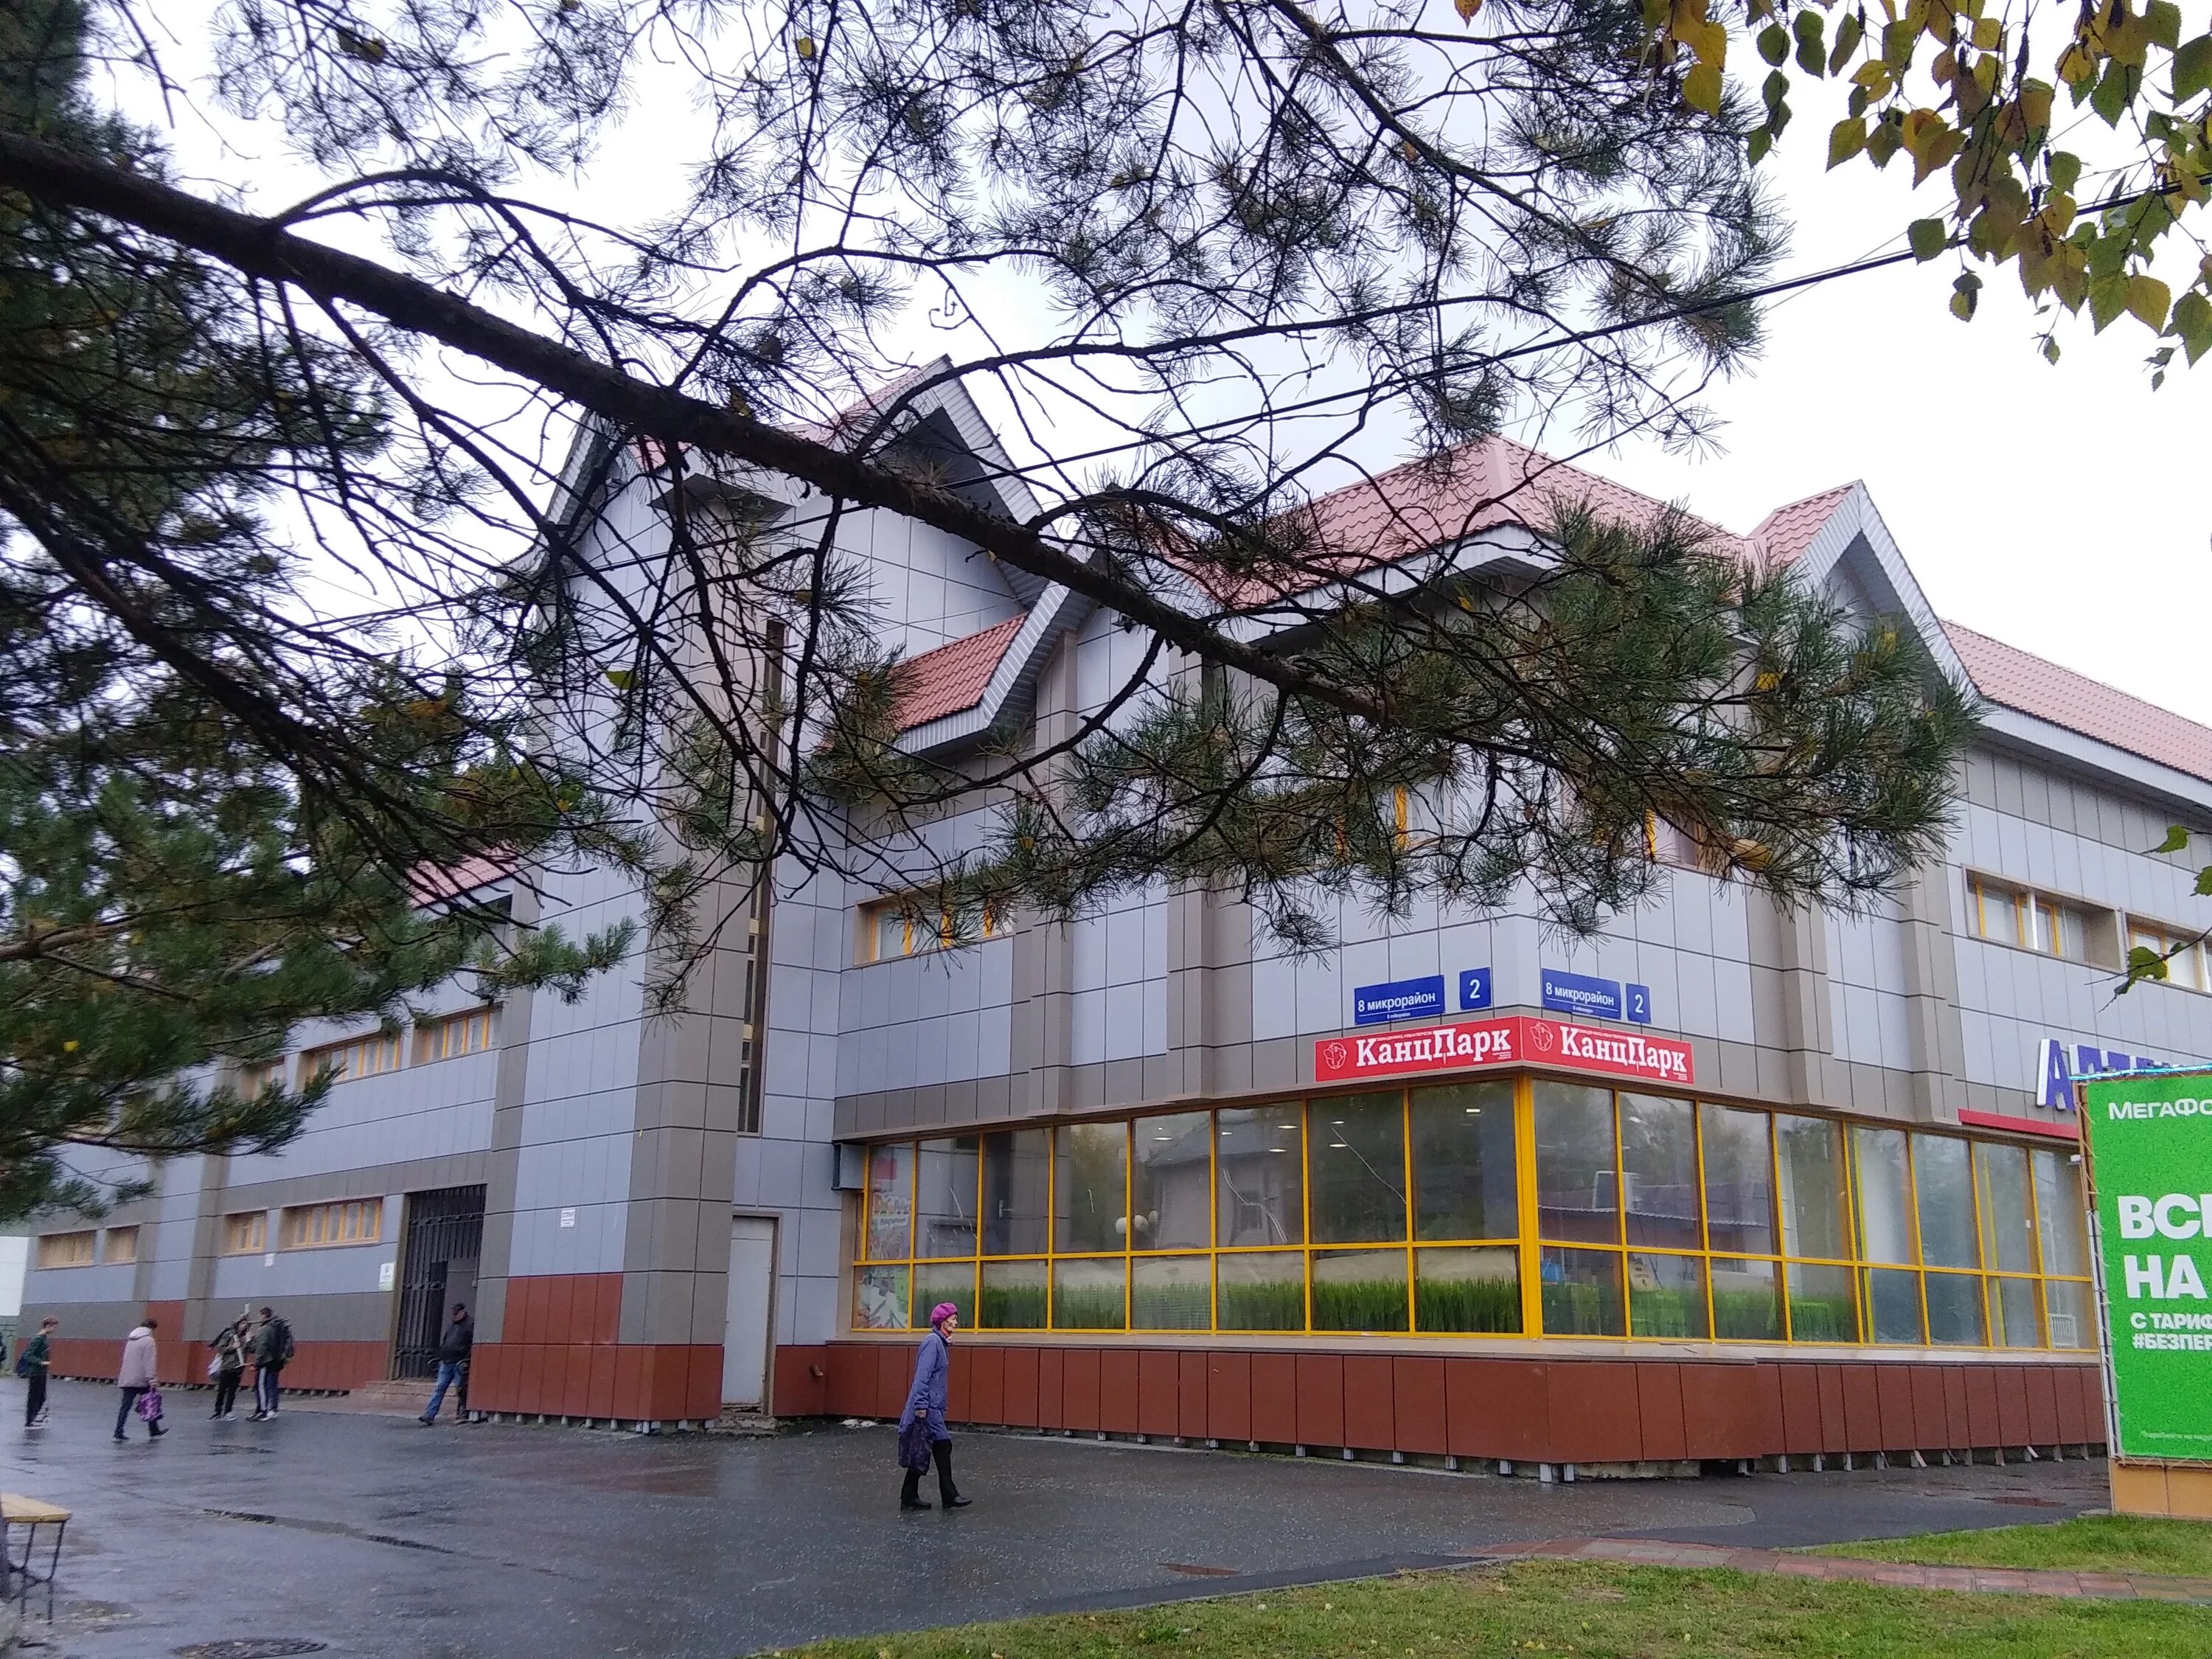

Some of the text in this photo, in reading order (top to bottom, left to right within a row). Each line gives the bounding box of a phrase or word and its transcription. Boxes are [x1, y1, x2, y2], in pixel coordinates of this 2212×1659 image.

[1470, 979, 1481, 999] 2
[1545, 982, 1615, 1006] 8 микрорайон
[1357, 992, 1436, 1012] 8 микрорайон
[1635, 994, 1644, 1014] 2
[1356, 1028, 1512, 1067] КанцПарк
[1559, 1026, 1688, 1077] КанцПарк
[2124, 1254, 2208, 1299] НА
[2130, 1312, 2147, 1329] С
